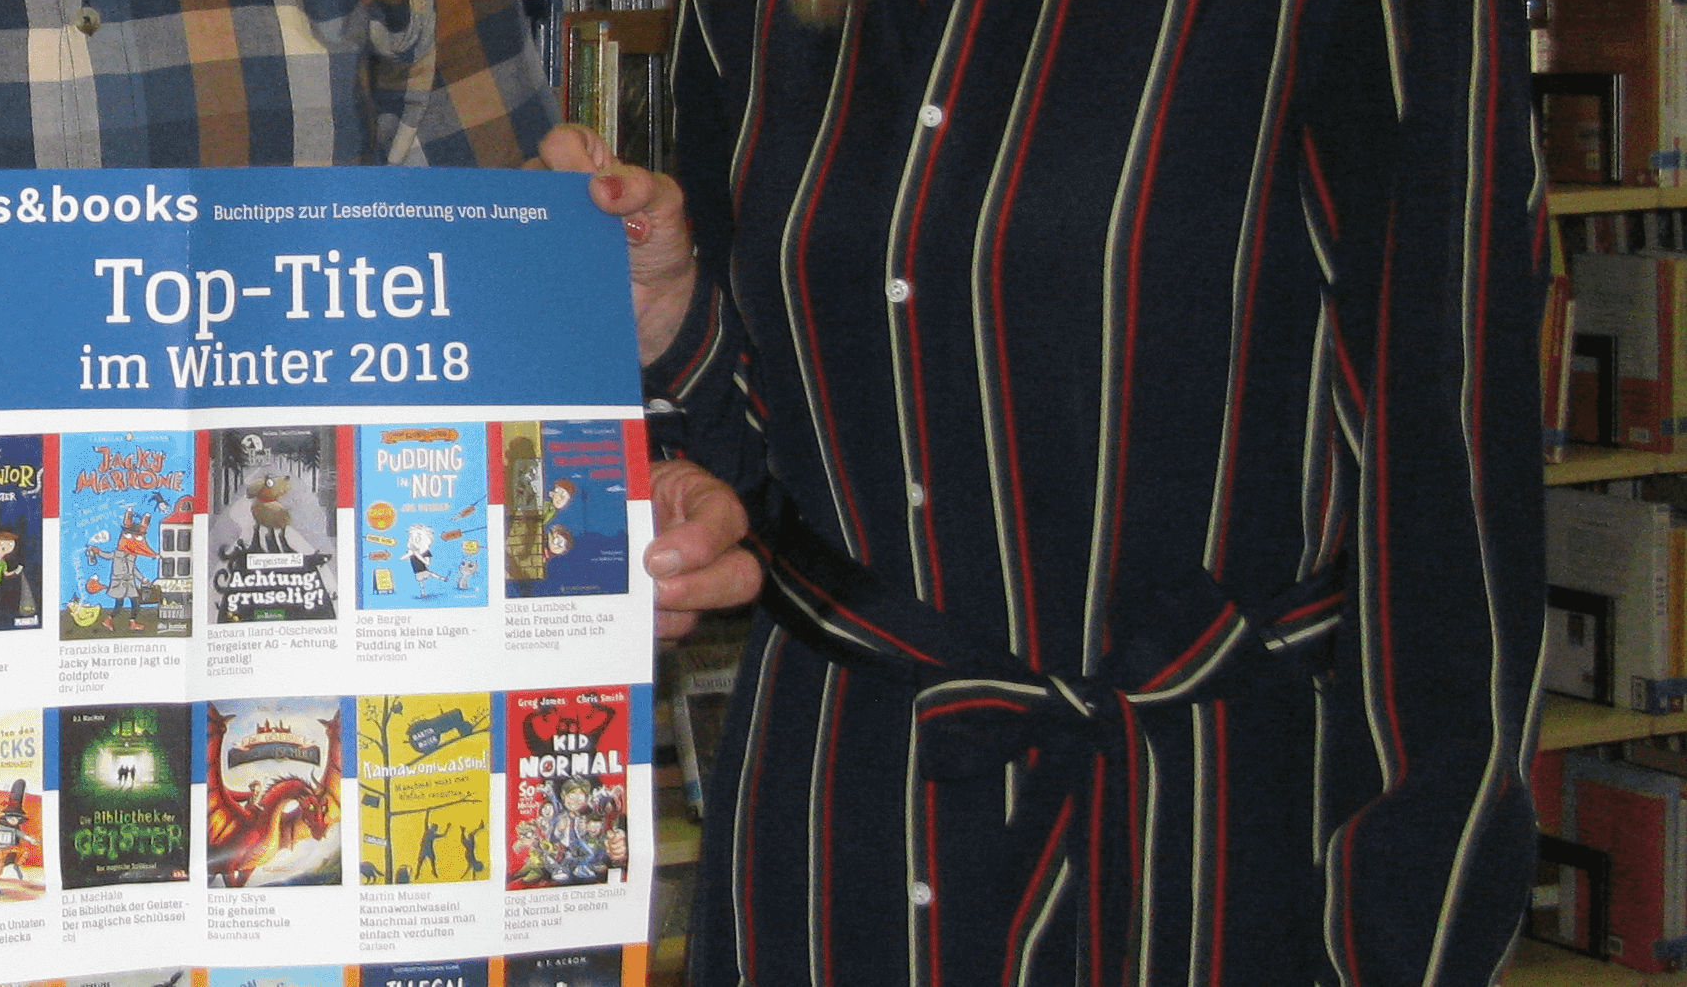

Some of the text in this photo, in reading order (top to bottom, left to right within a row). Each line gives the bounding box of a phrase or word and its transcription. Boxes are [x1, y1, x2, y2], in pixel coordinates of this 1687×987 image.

[214, 202, 547, 223] Buchtipps zur Leseförderung von Jungen
[94, 250, 451, 341] Top-Titel
[80, 341, 470, 390] im Winter 2018
[412, 473, 458, 498] NOT
[230, 570, 320, 590] Achtung,
[228, 587, 323, 611] gruselig!
[532, 602, 576, 612] Lambeck
[355, 615, 412, 626] Joe Berger
[505, 616, 530, 626] Mein
[533, 615, 568, 625] Freund
[596, 613, 614, 622] das
[207, 628, 244, 639] Barbara
[356, 626, 469, 638] Simons kleine Lügen
[535, 628, 564, 638] Leben
[567, 627, 586, 636] und
[59, 643, 166, 655] Franziska Biermann
[207, 641, 261, 652] Tiergeister
[265, 640, 278, 649] AG
[356, 640, 437, 652] Pudding in Not
[59, 658, 89, 670] Jacky
[92, 657, 136, 668] Marrone
[163, 655, 180, 665] die
[553, 733, 588, 751] KID
[519, 750, 623, 778] NORMAL
[519, 780, 535, 796] So
[80, 890, 123, 902] MacHale
[207, 894, 266, 904] Emily Skye
[360, 892, 431, 902] Martin Muser
[570, 890, 595, 900] Chris
[62, 899, 183, 917] Die Bibliothek der Geister
[207, 906, 275, 918] Die geheime
[504, 908, 520, 918] Kid
[563, 903, 576, 912] So
[8, 918, 45, 930] Untaten
[63, 912, 185, 930] Der magische Schlüssel
[207, 918, 290, 928] Drachenschule
[360, 913, 475, 927] Manchmal muss man
[504, 920, 539, 930] Helden
[360, 928, 454, 940] einfach verduften
